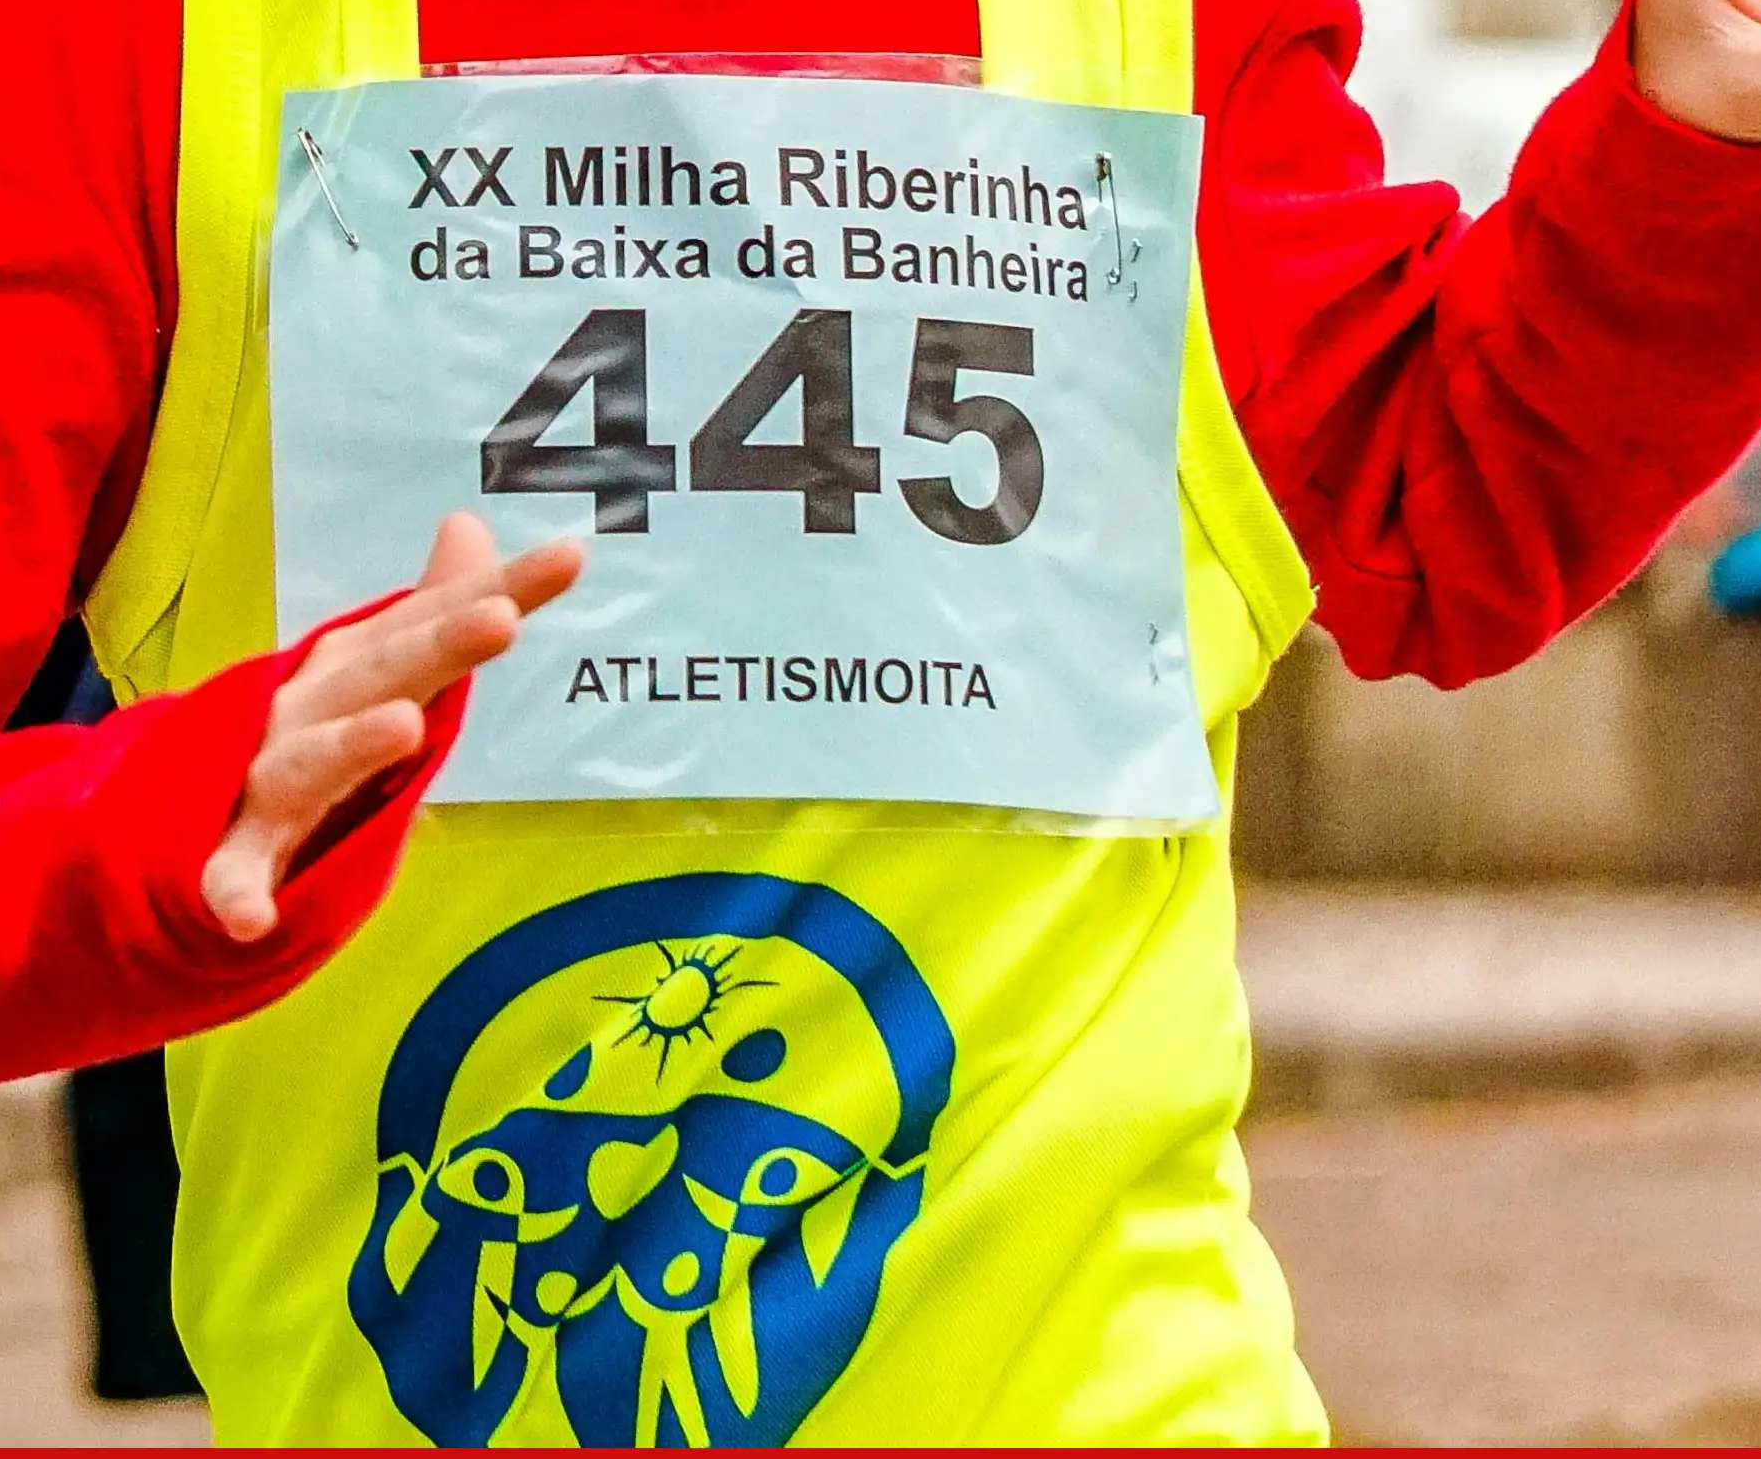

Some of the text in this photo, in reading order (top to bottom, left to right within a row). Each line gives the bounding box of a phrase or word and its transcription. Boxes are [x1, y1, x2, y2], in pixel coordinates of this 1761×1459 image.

[409, 146, 1088, 231] XX Milha Riberinha
[410, 225, 1088, 302] da Baixa da Banheira
[480, 309, 1045, 546] 445
[566, 657, 996, 710] ATLETISMOITA
